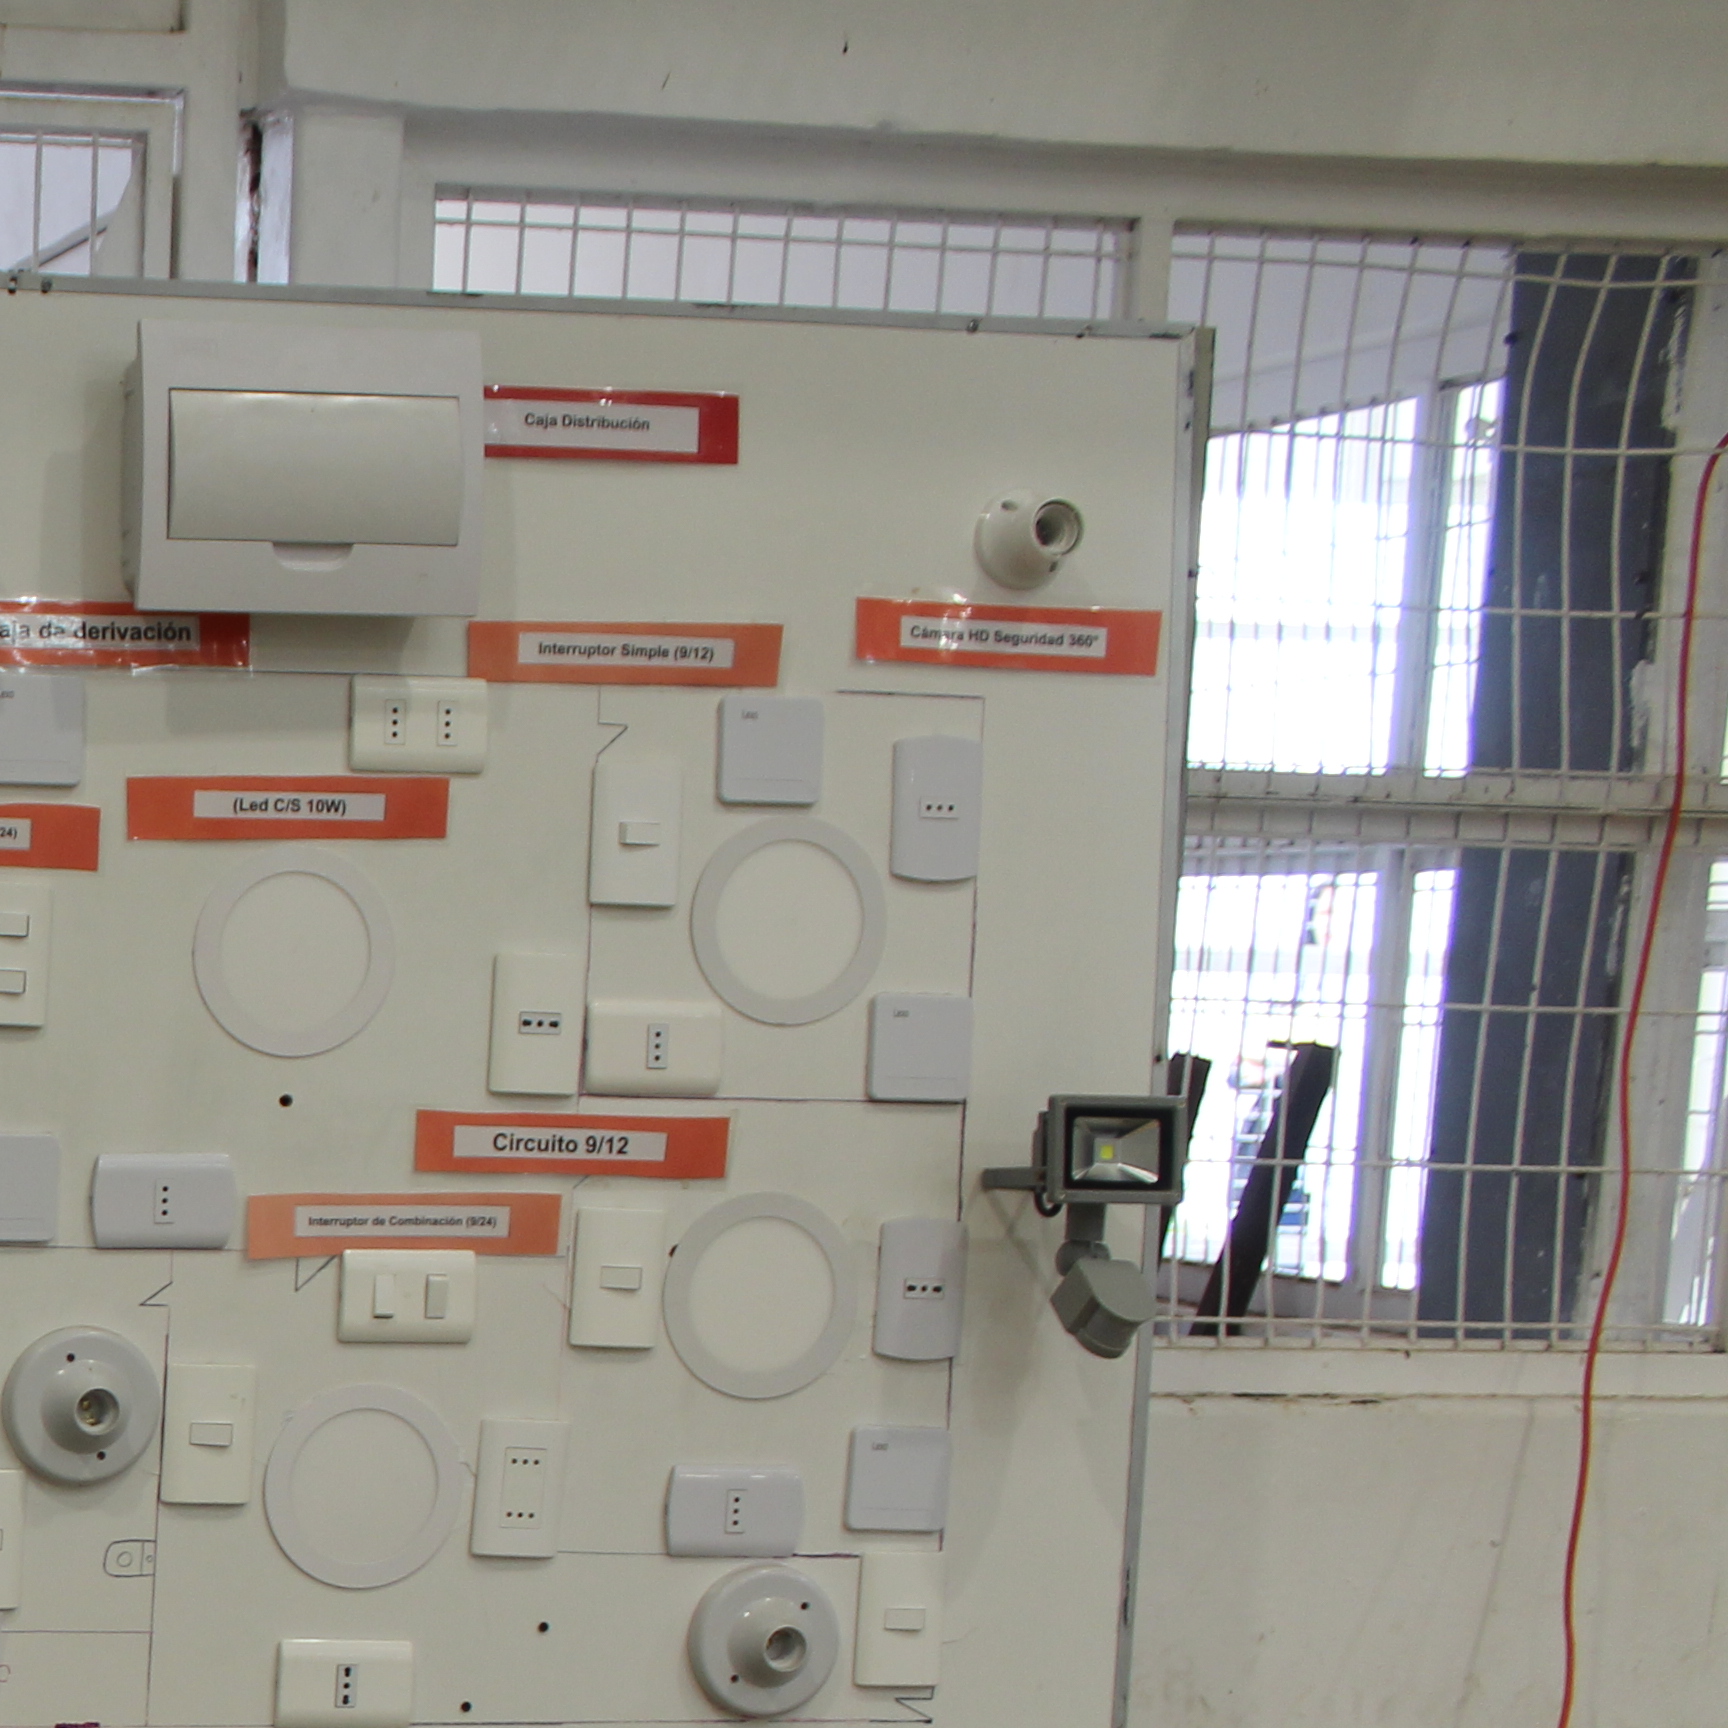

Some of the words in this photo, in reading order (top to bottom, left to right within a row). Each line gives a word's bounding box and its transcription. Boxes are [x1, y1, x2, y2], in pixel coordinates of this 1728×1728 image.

[524, 412, 558, 431] Caja
[562, 413, 650, 432] Distribución
[74, 621, 192, 641] derivación
[969, 628, 990, 642] HD
[994, 630, 1064, 647] Seguridad
[538, 642, 617, 660] Interruptor
[622, 643, 670, 662] Simple
[674, 645, 715, 664] (9/12)
[233, 797, 269, 816] (Led
[273, 798, 302, 815] C/S
[307, 798, 347, 817] 10W)
[493, 1131, 580, 1156] Circuito
[585, 1134, 630, 1156] 9/12
[308, 1214, 369, 1231] Interruptor
[372, 1215, 387, 1227] de
[389, 1214, 463, 1228] Combinación
[466, 1215, 498, 1230] (9/24)
